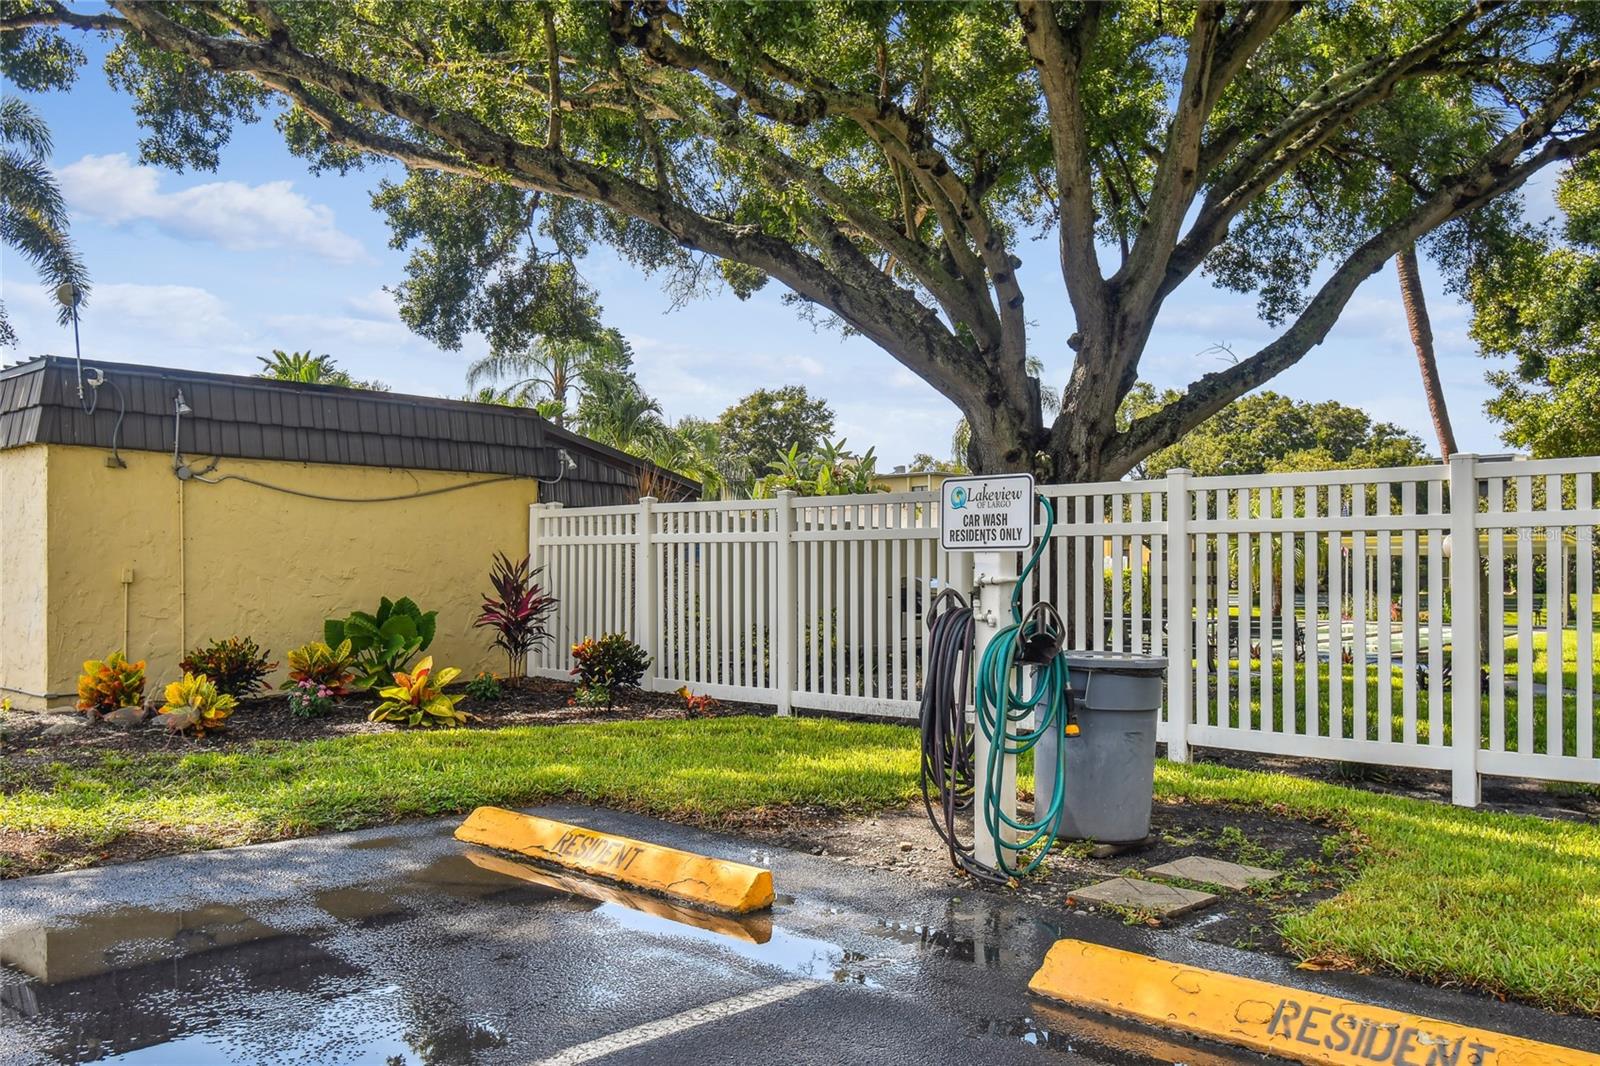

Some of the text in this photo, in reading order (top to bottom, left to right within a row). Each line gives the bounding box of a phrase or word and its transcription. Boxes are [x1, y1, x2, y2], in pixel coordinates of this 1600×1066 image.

[967, 486, 1023, 502] Lakeview
[987, 501, 1011, 509] LARGO
[963, 513, 1008, 527] CAR WASH
[949, 528, 1023, 542] RESIDENTS ONLY
[552, 830, 645, 871] RESIDENT
[1267, 999, 1496, 1066] RESIDENT
